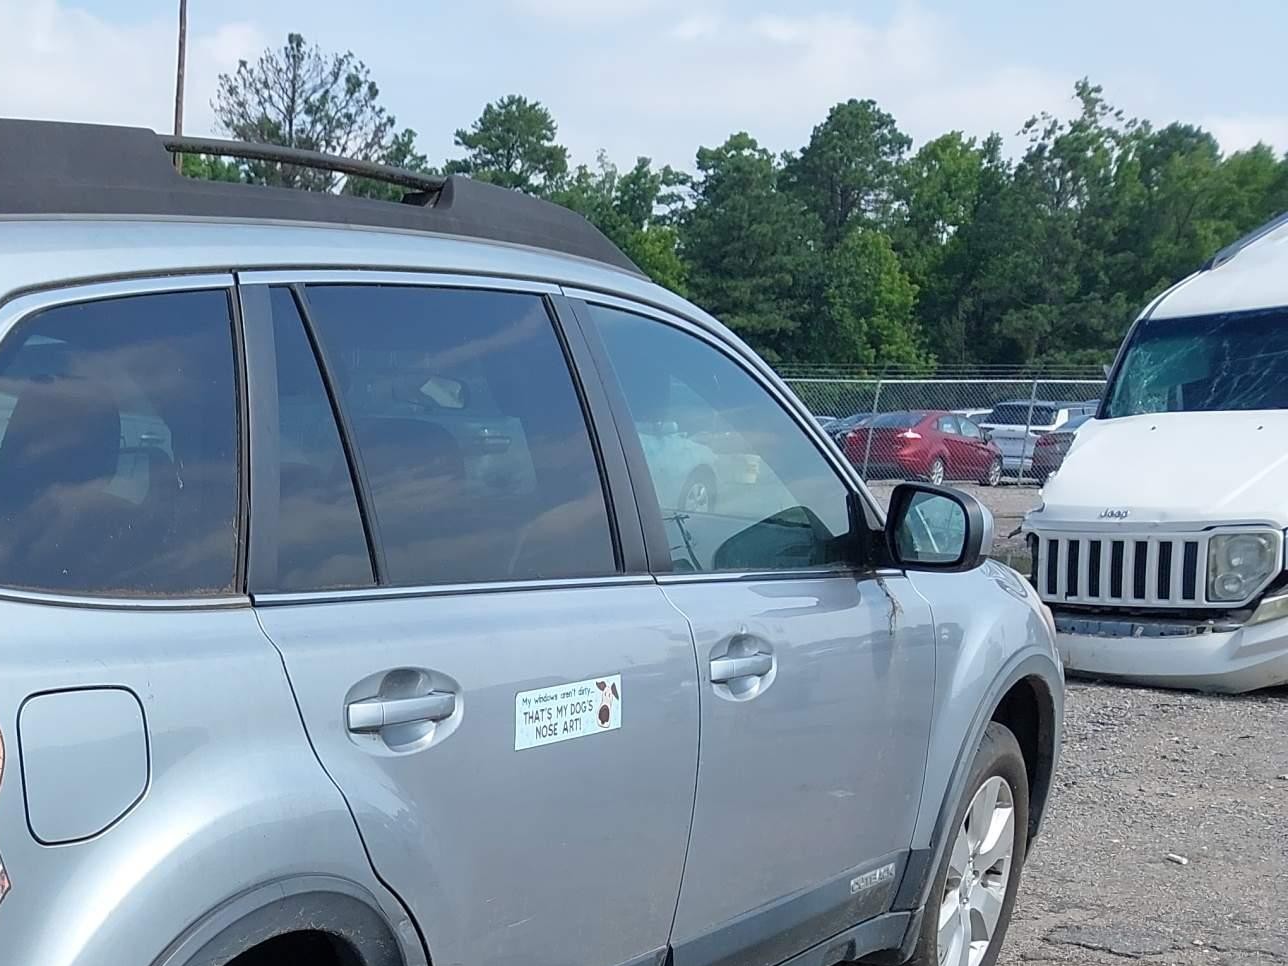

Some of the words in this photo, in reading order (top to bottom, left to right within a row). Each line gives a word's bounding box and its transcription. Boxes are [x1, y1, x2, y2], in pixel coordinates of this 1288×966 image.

[523, 707, 553, 726] THAT'S
[556, 704, 569, 718] MY
[570, 699, 594, 716] DOG'S
[535, 722, 558, 740] NOSE
[562, 717, 582, 735] ART!
